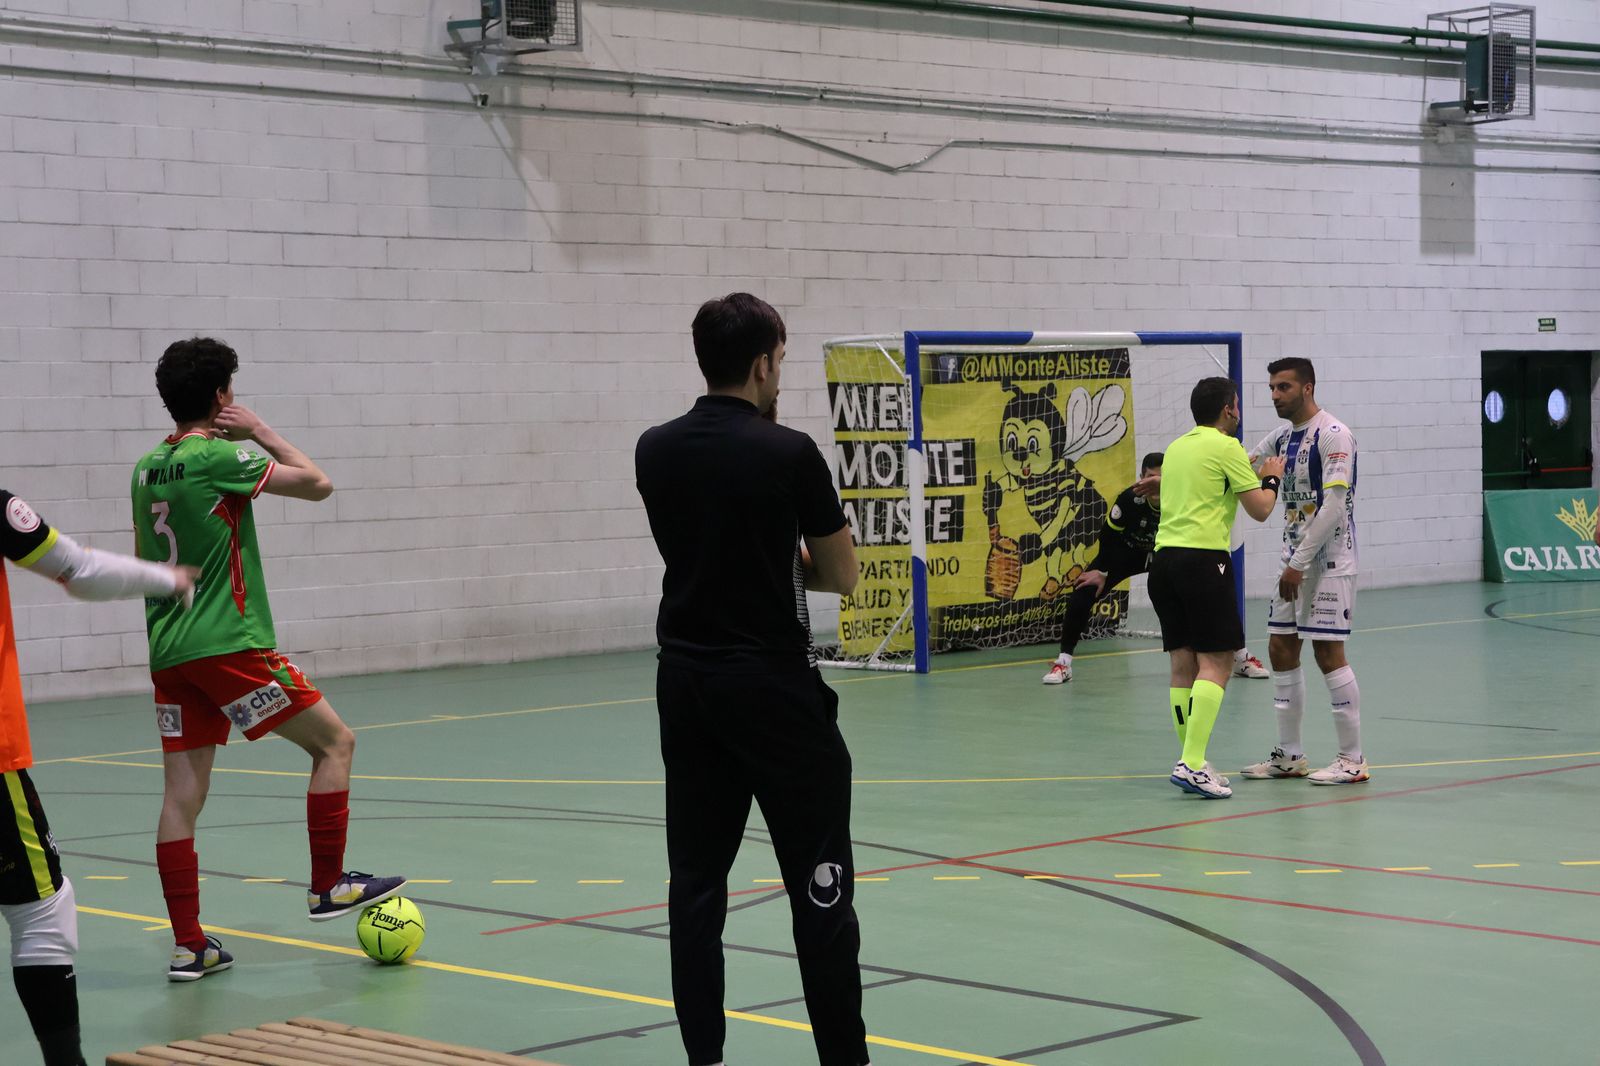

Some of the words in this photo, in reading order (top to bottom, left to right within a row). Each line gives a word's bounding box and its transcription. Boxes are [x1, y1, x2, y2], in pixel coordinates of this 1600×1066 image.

[961, 352, 1110, 383] @MMonteAliste
[151, 501, 178, 567] 3
[1504, 546, 1578, 571] CAJA
[840, 588, 891, 612] SALUD
[898, 588, 910, 608] Y
[943, 612, 1000, 633] Trabazos
[1003, 611, 1021, 626] de
[250, 686, 282, 710] chc
